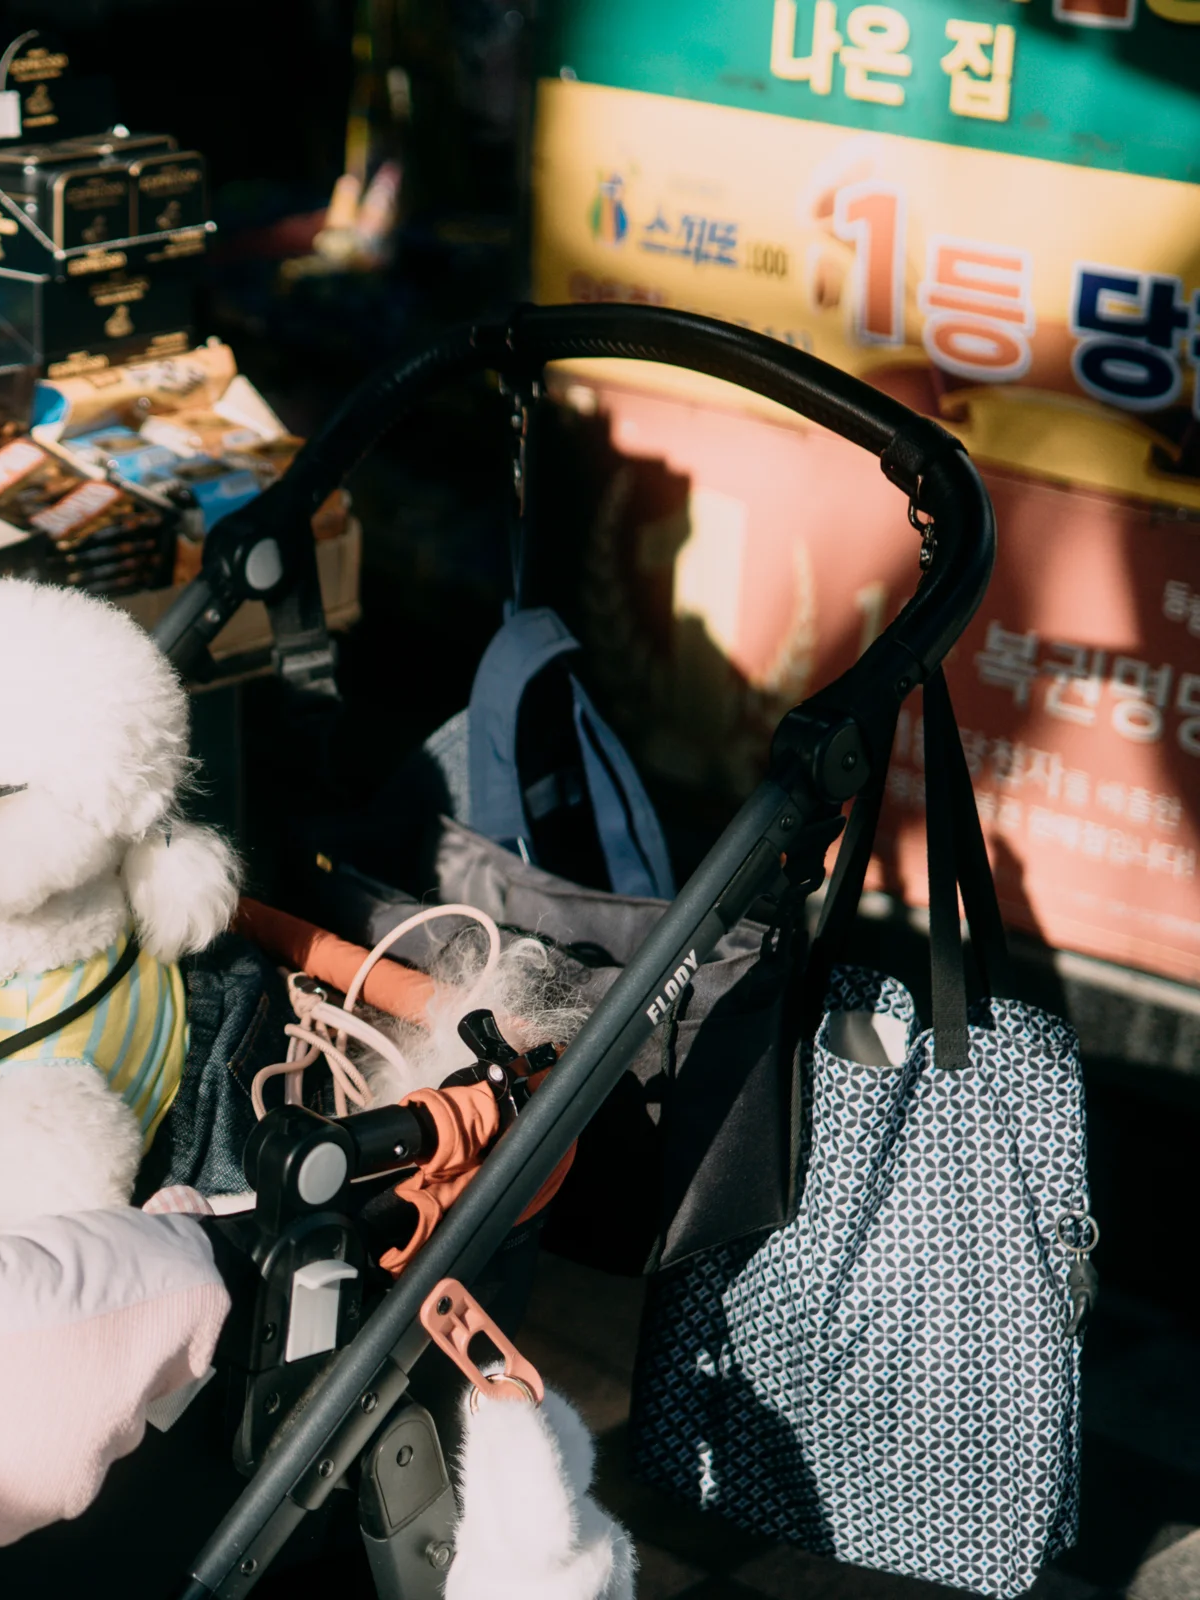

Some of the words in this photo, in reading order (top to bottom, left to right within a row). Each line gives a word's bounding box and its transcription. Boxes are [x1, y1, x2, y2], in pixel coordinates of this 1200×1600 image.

[770, 0, 912, 107] 나온
[939, 18, 1016, 122] 집
[837, 183, 1030, 378] 1등
[1075, 263, 1200, 412] 당
[645, 949, 699, 1026] FLODY
